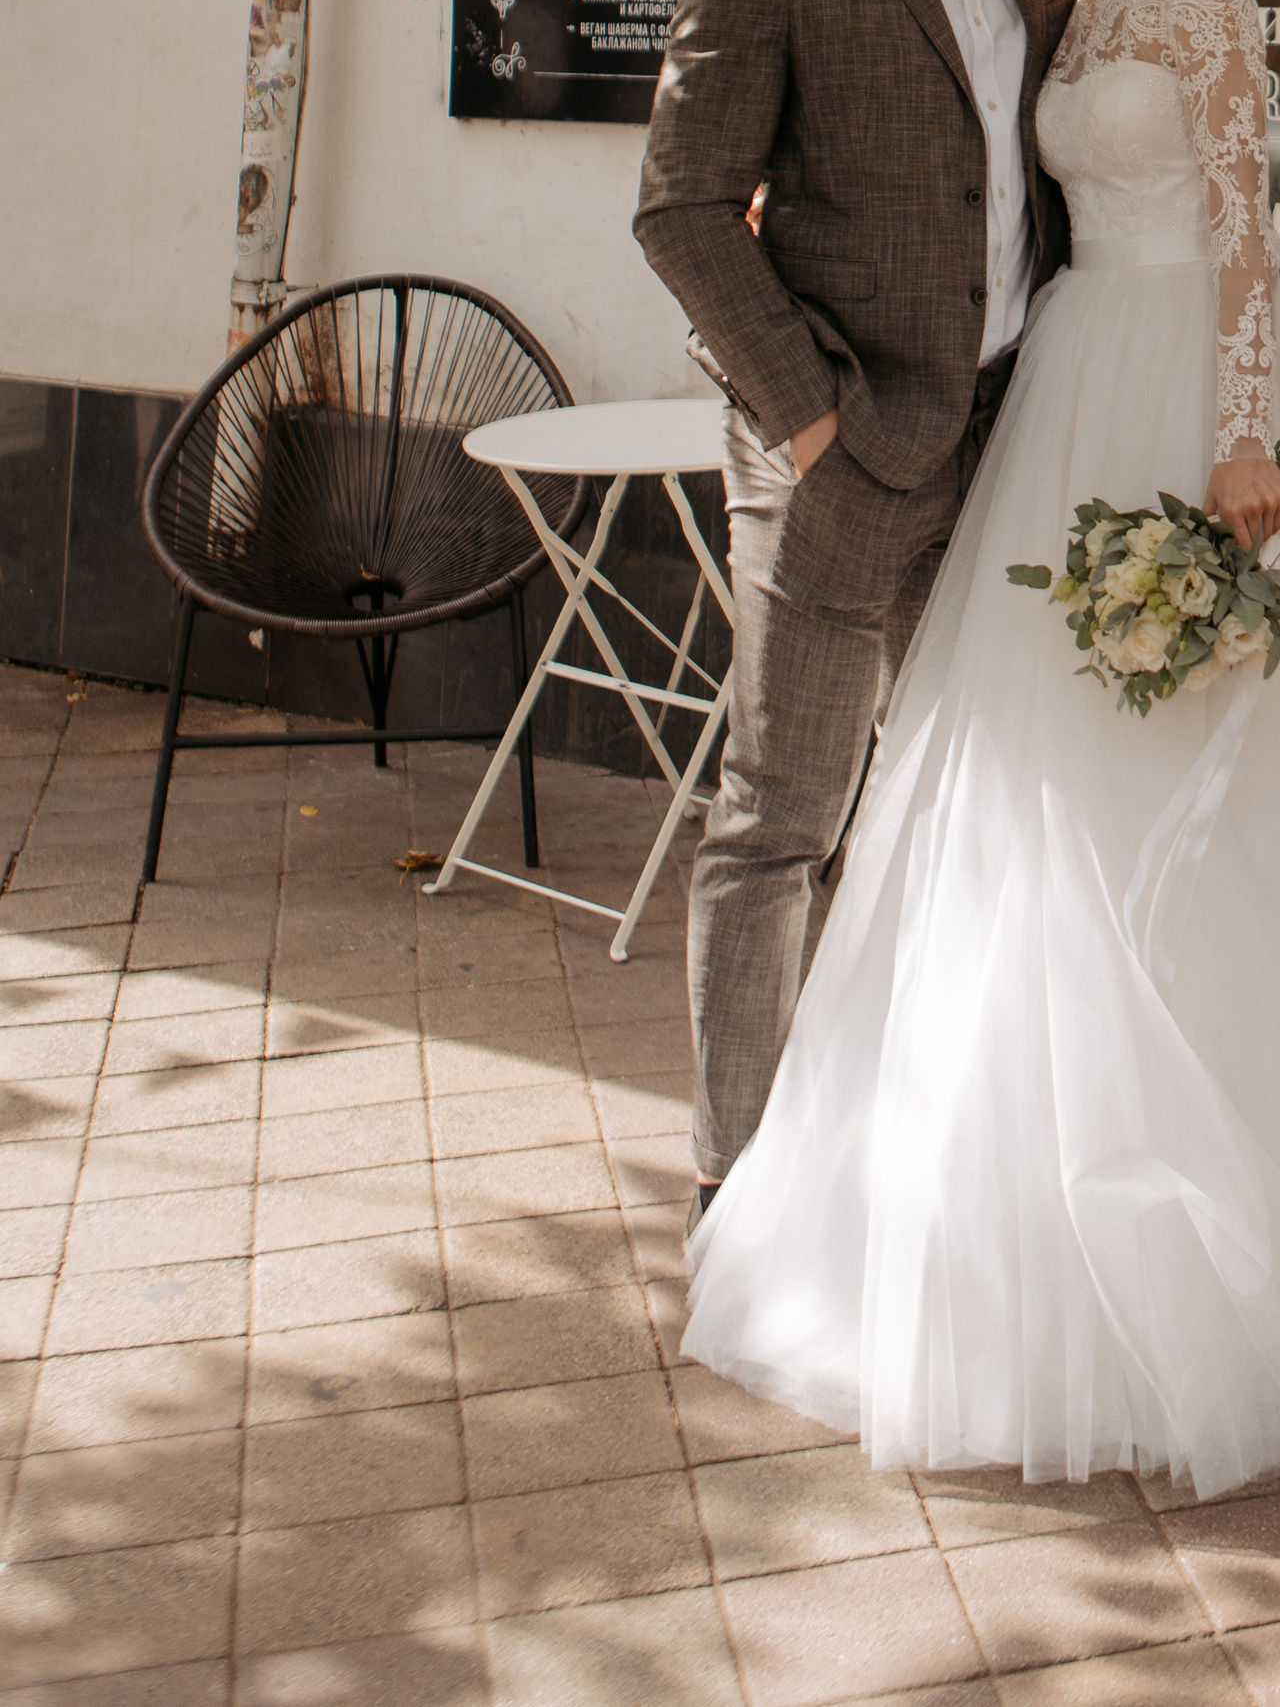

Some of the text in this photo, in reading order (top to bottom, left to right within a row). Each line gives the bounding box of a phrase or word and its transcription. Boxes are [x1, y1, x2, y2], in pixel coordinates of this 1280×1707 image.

[620, 3, 625, 15] И
[580, 22, 605, 35] ВЕГАН
[608, 22, 648, 35] ШАВЕРМА
[651, 23, 656, 35] С
[592, 37, 650, 50] БАКЛАЖАНОМ
